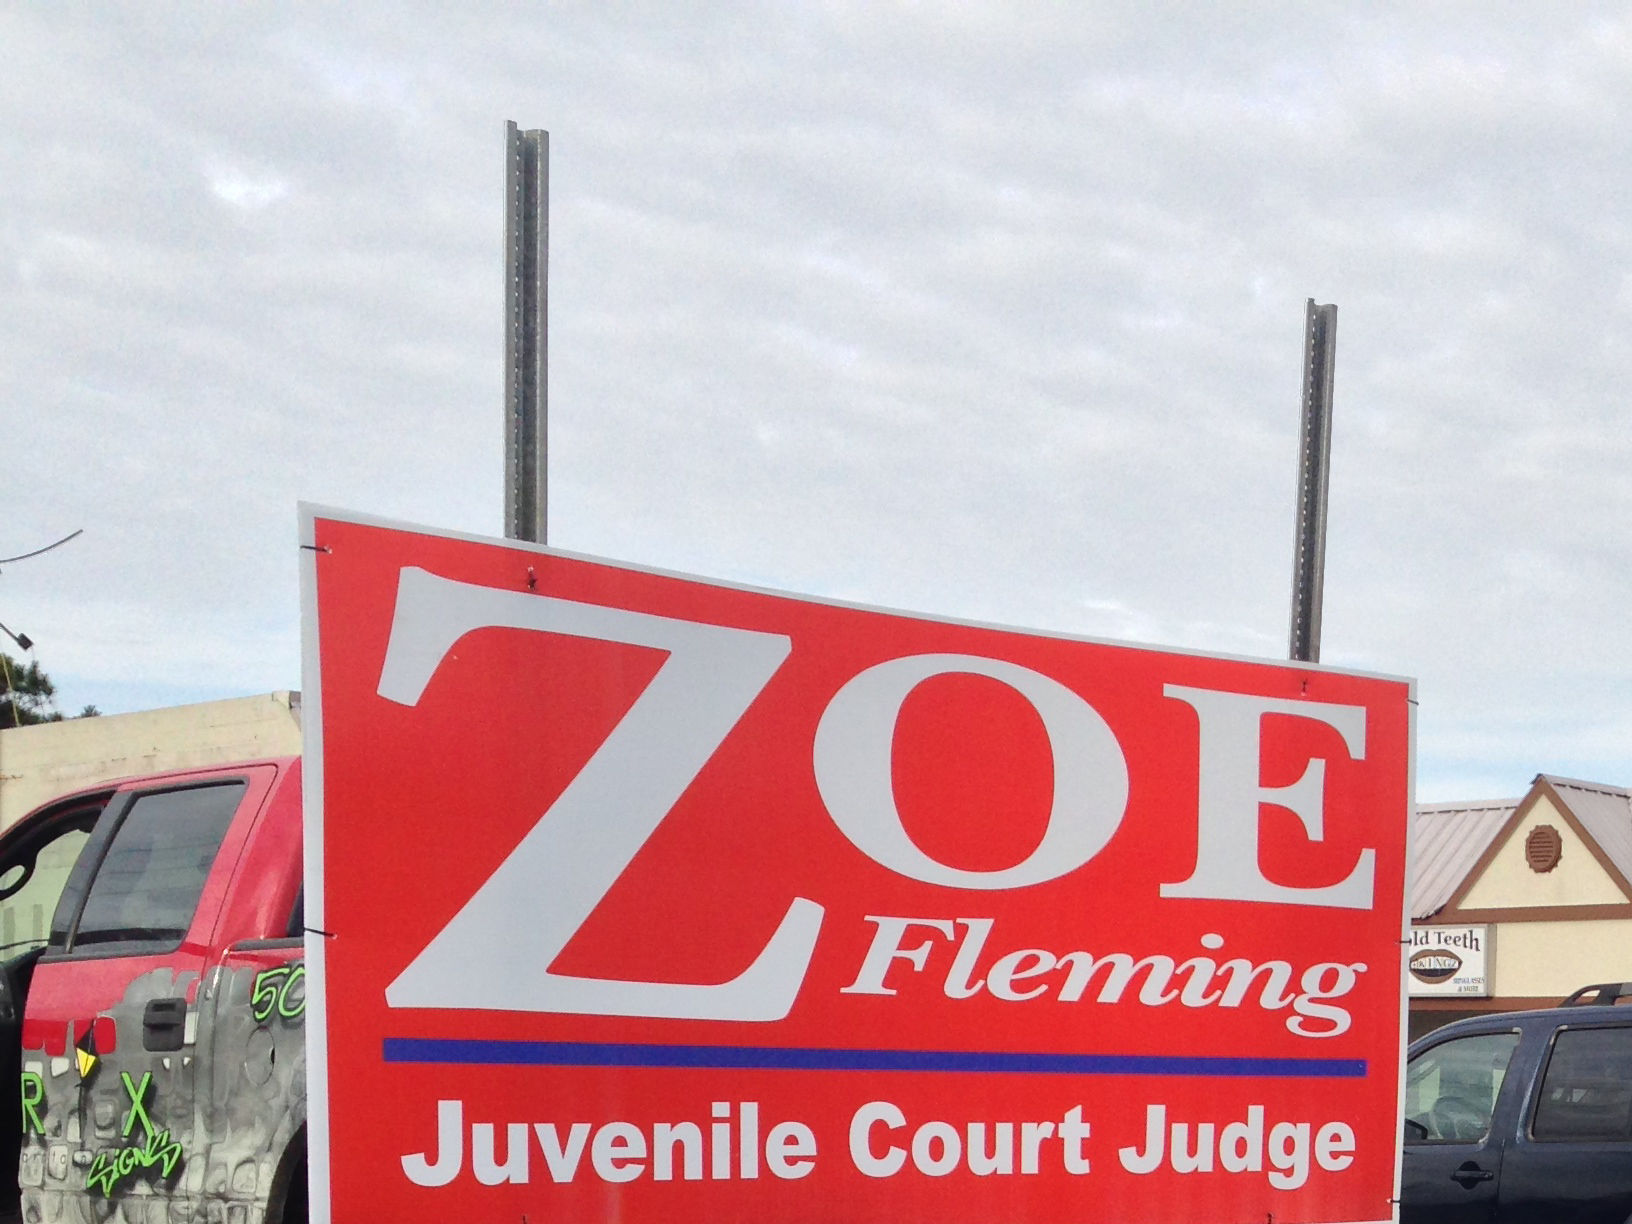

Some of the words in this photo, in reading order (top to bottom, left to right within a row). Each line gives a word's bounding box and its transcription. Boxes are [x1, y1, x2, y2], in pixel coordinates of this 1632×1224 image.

[376, 566, 1377, 1023] ZOE
[841, 915, 1368, 1038] Fleming
[1434, 930, 1481, 951] Teeth
[400, 1100, 818, 1187] Juvenile
[847, 1102, 1093, 1178] Court
[1118, 1104, 1357, 1191] Judge
